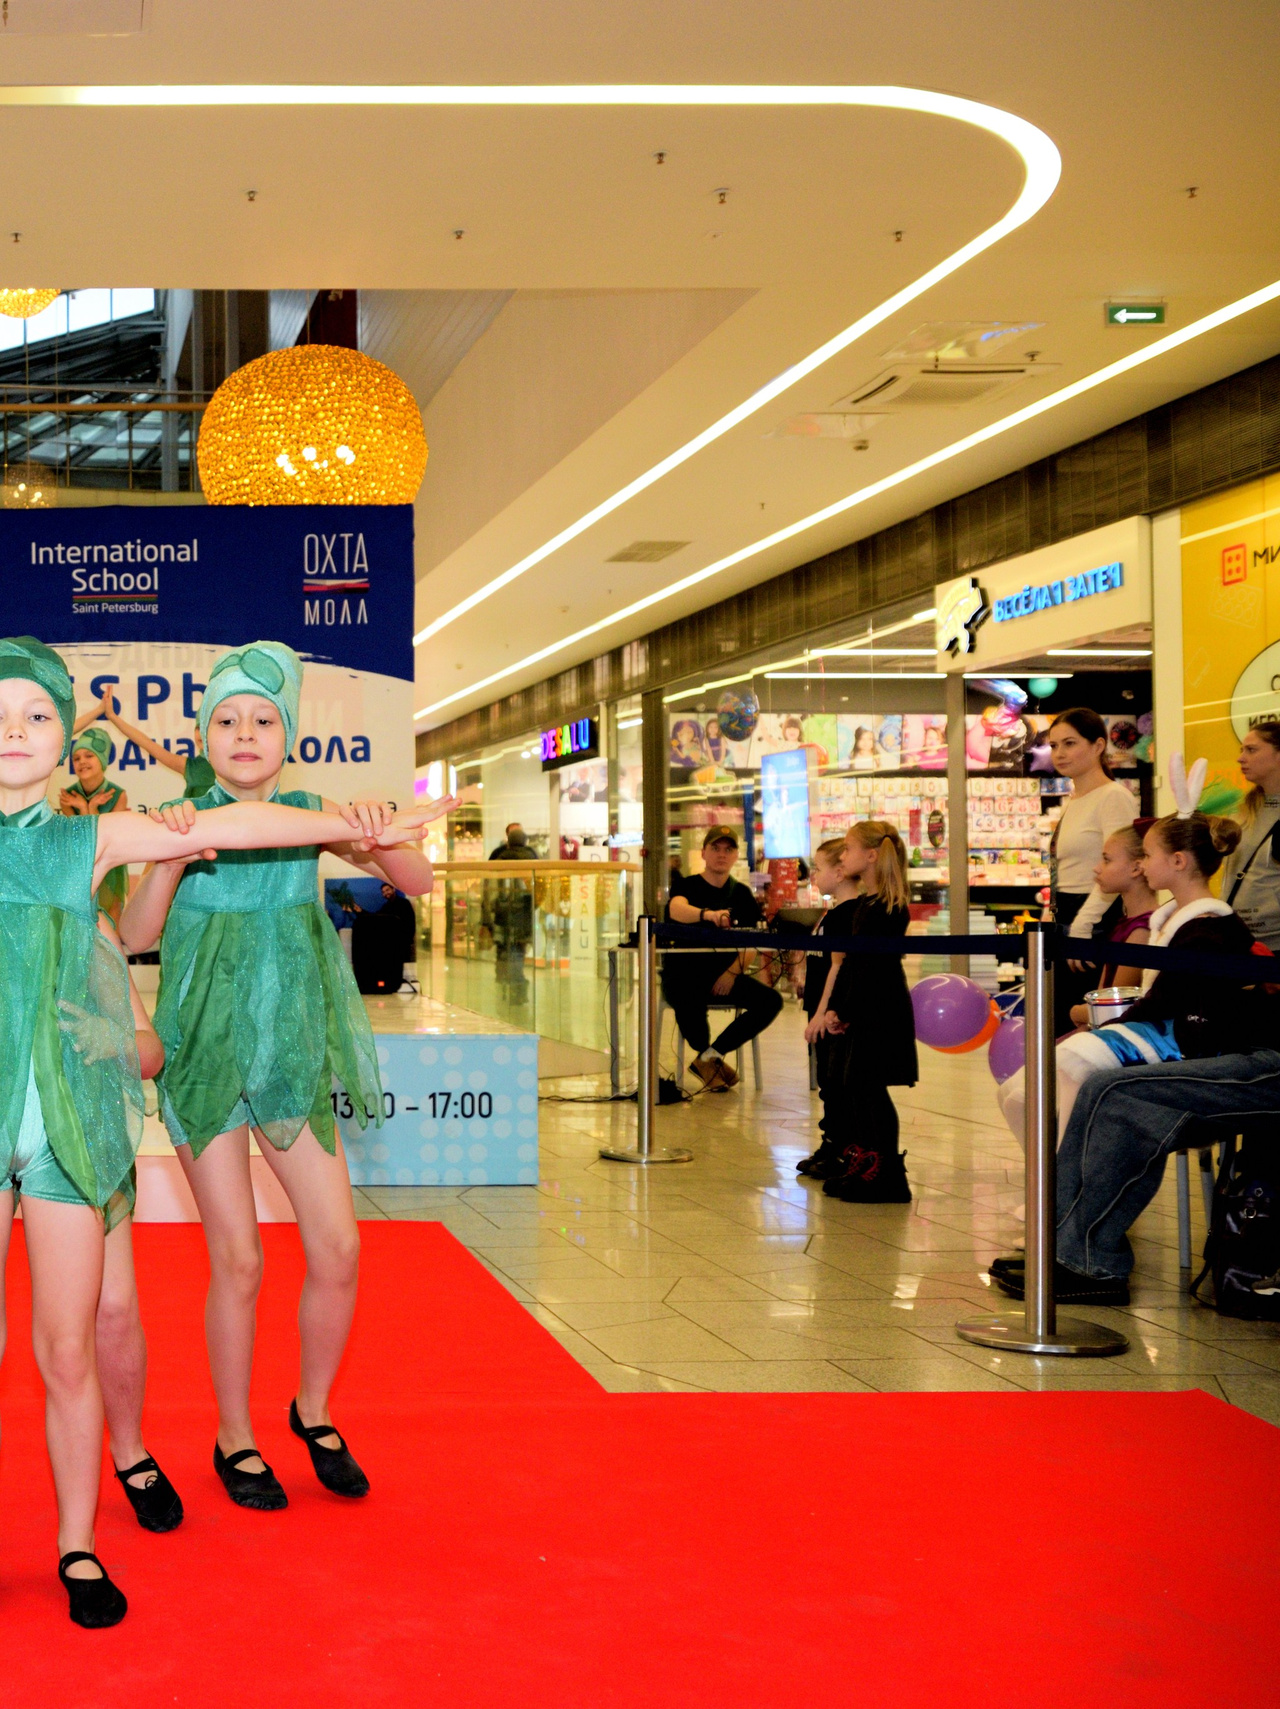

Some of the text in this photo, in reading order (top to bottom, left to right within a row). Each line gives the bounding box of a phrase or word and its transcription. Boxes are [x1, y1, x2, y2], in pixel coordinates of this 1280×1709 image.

[30, 538, 198, 565] International
[303, 532, 369, 576] ОХТА
[71, 566, 159, 593] School
[992, 561, 1123, 623] ВЕСЁЛАЯ ЗАТЕЯ
[72, 601, 159, 615] Saint Petersburg
[539, 717, 591, 762] DESALU
[428, 1091, 493, 1119] 17:00
